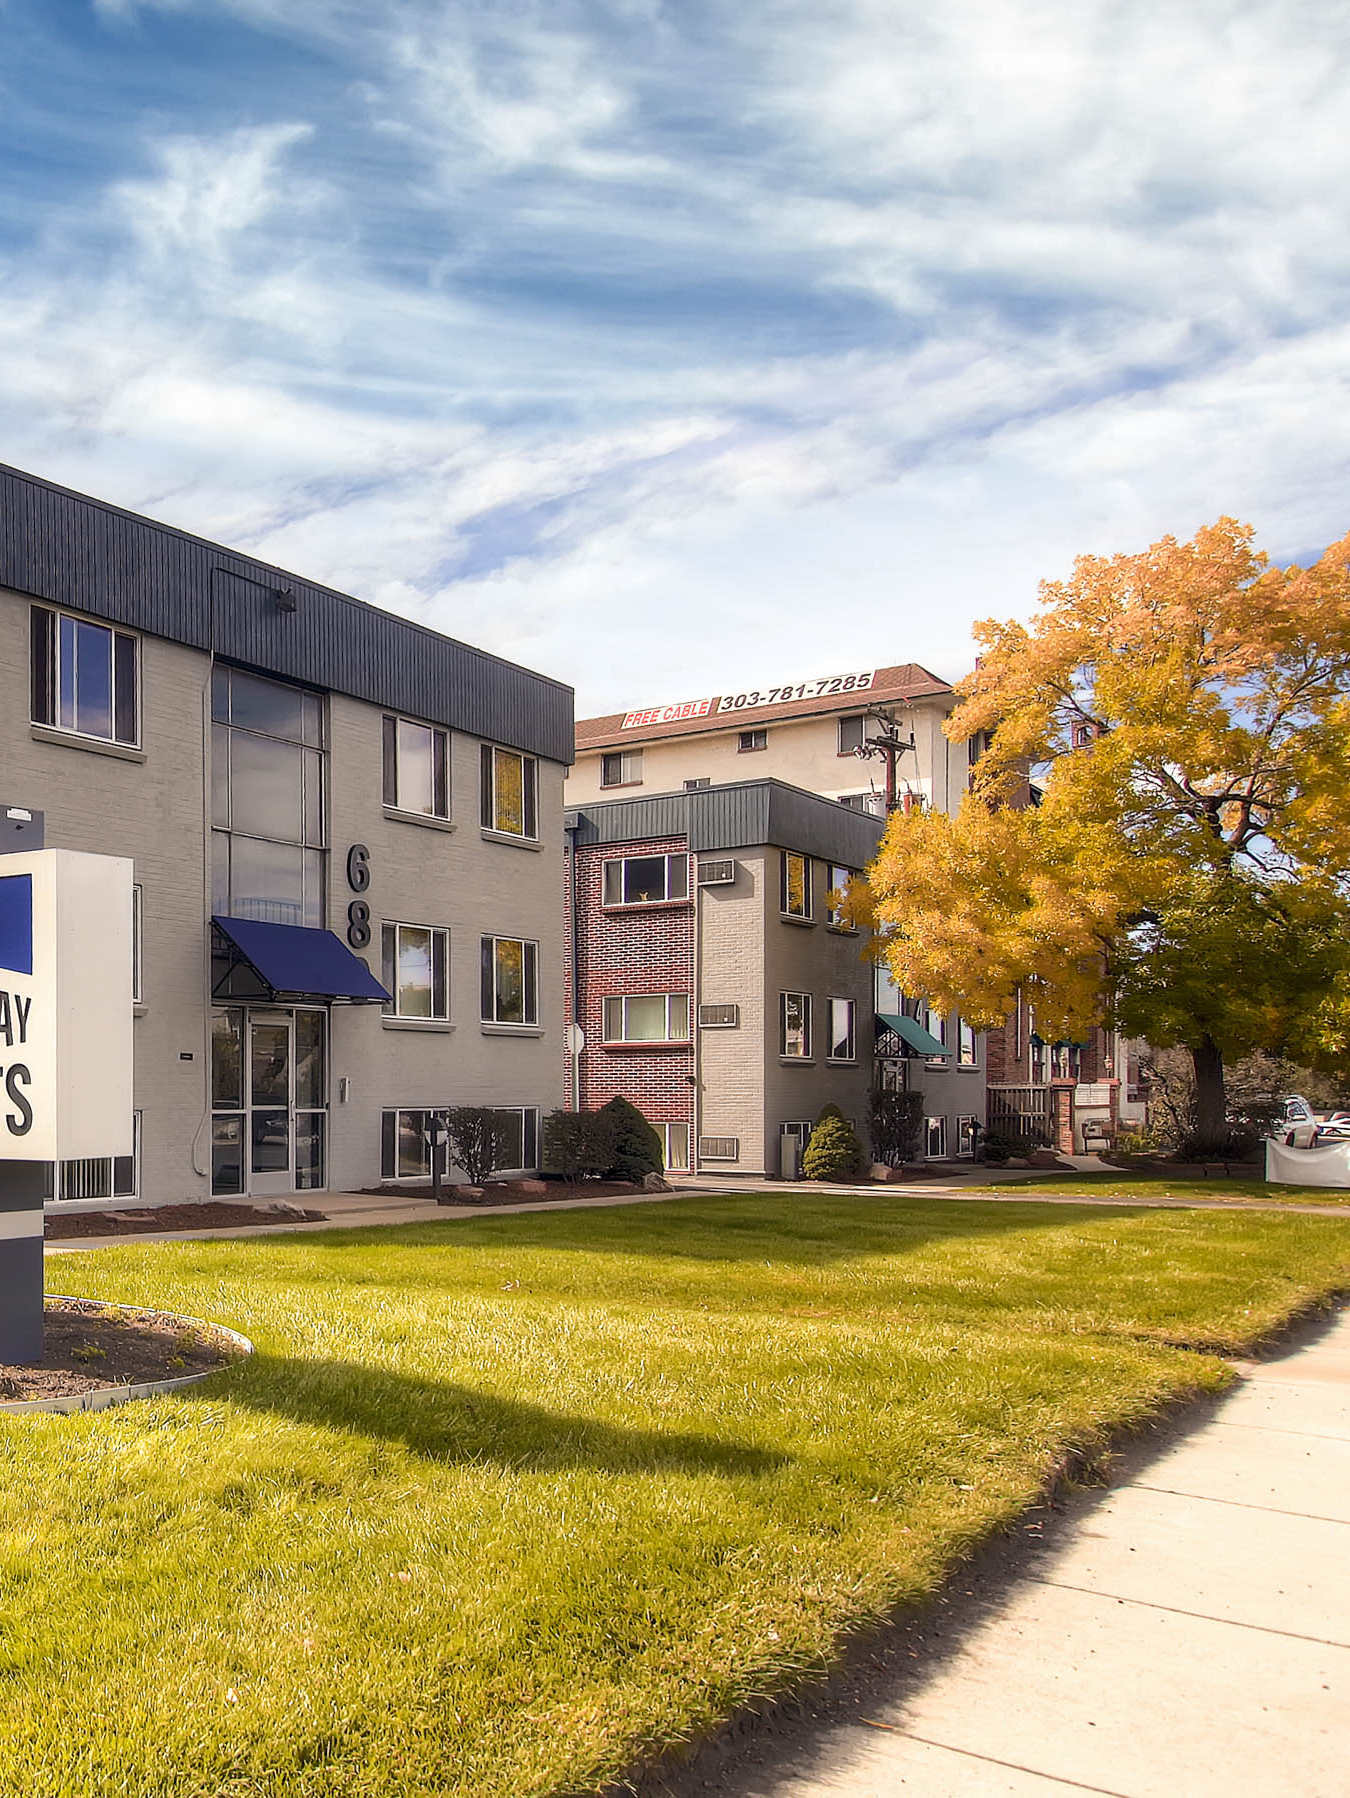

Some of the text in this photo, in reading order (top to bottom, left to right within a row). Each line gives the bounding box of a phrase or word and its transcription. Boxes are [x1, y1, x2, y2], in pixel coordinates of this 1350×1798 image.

[721, 673, 872, 711] 303-781-7285
[624, 701, 710, 727] FREE CABLE
[347, 843, 371, 973] 68
